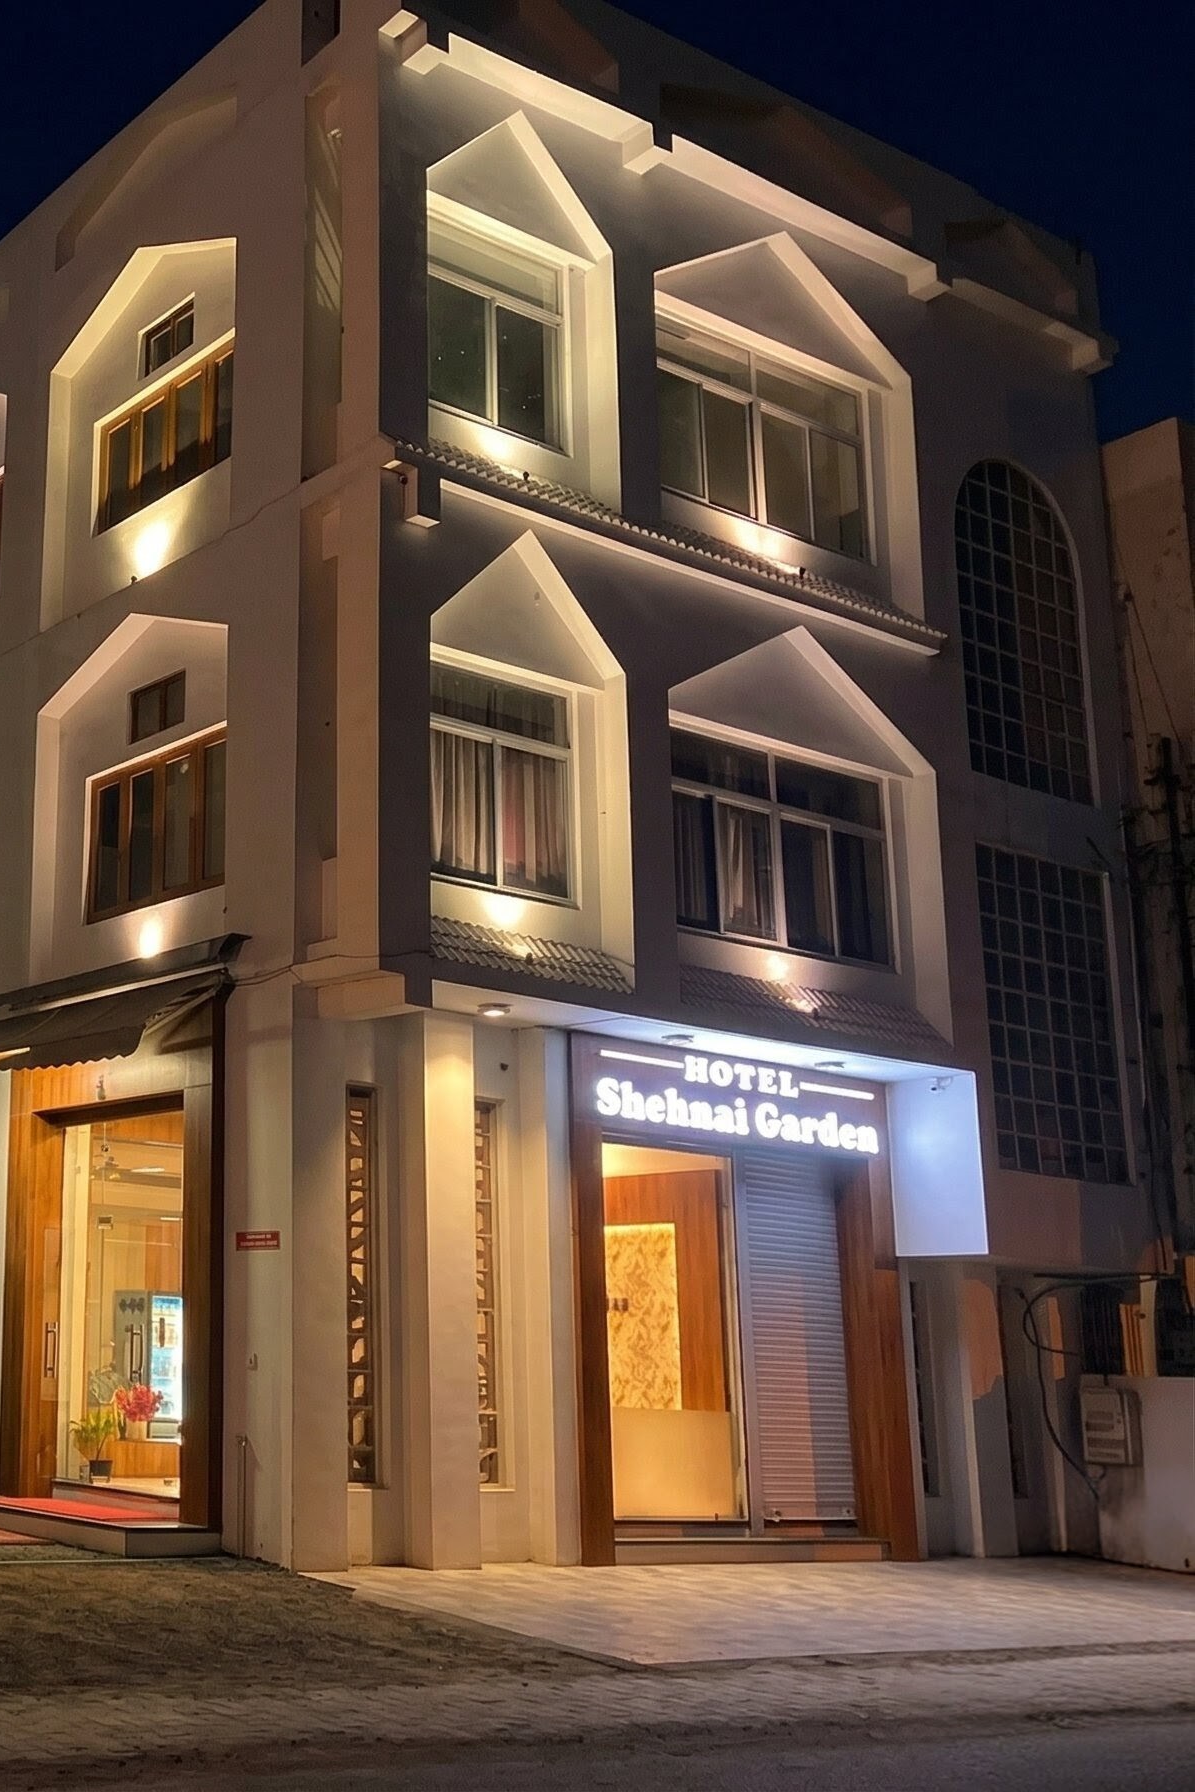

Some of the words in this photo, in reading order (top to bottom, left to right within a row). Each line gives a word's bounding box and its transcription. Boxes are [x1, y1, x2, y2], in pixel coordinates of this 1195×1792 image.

[683, 1055, 799, 1099] HOTEL
[596, 1077, 749, 1136] Shehnai
[754, 1105, 879, 1155] Garden
